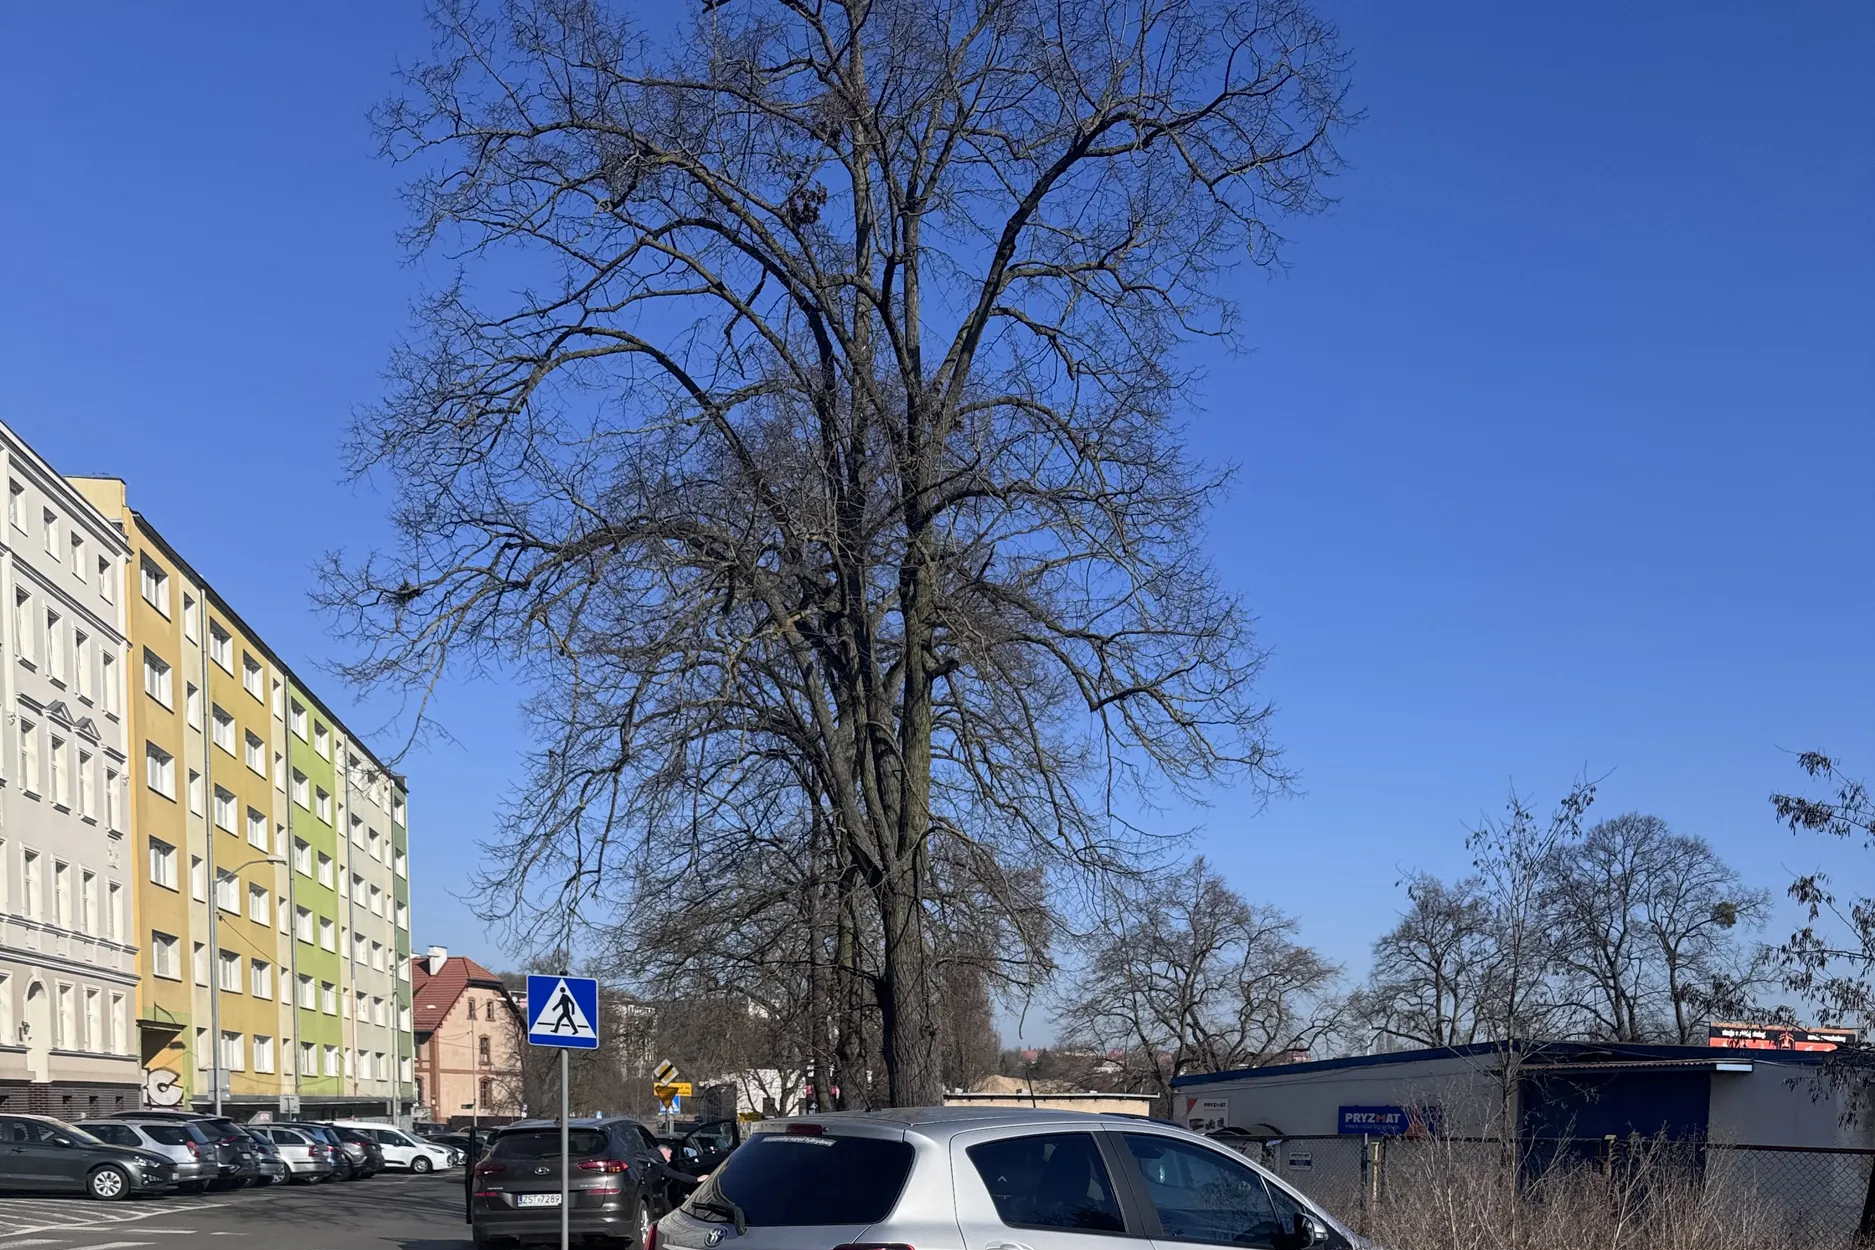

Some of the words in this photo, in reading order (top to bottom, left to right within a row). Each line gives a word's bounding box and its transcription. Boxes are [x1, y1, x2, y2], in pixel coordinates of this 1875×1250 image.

[1344, 1112, 1402, 1124] PRYZMAT
[522, 1195, 539, 1204] ZST
[540, 1194, 560, 1204] 7289
